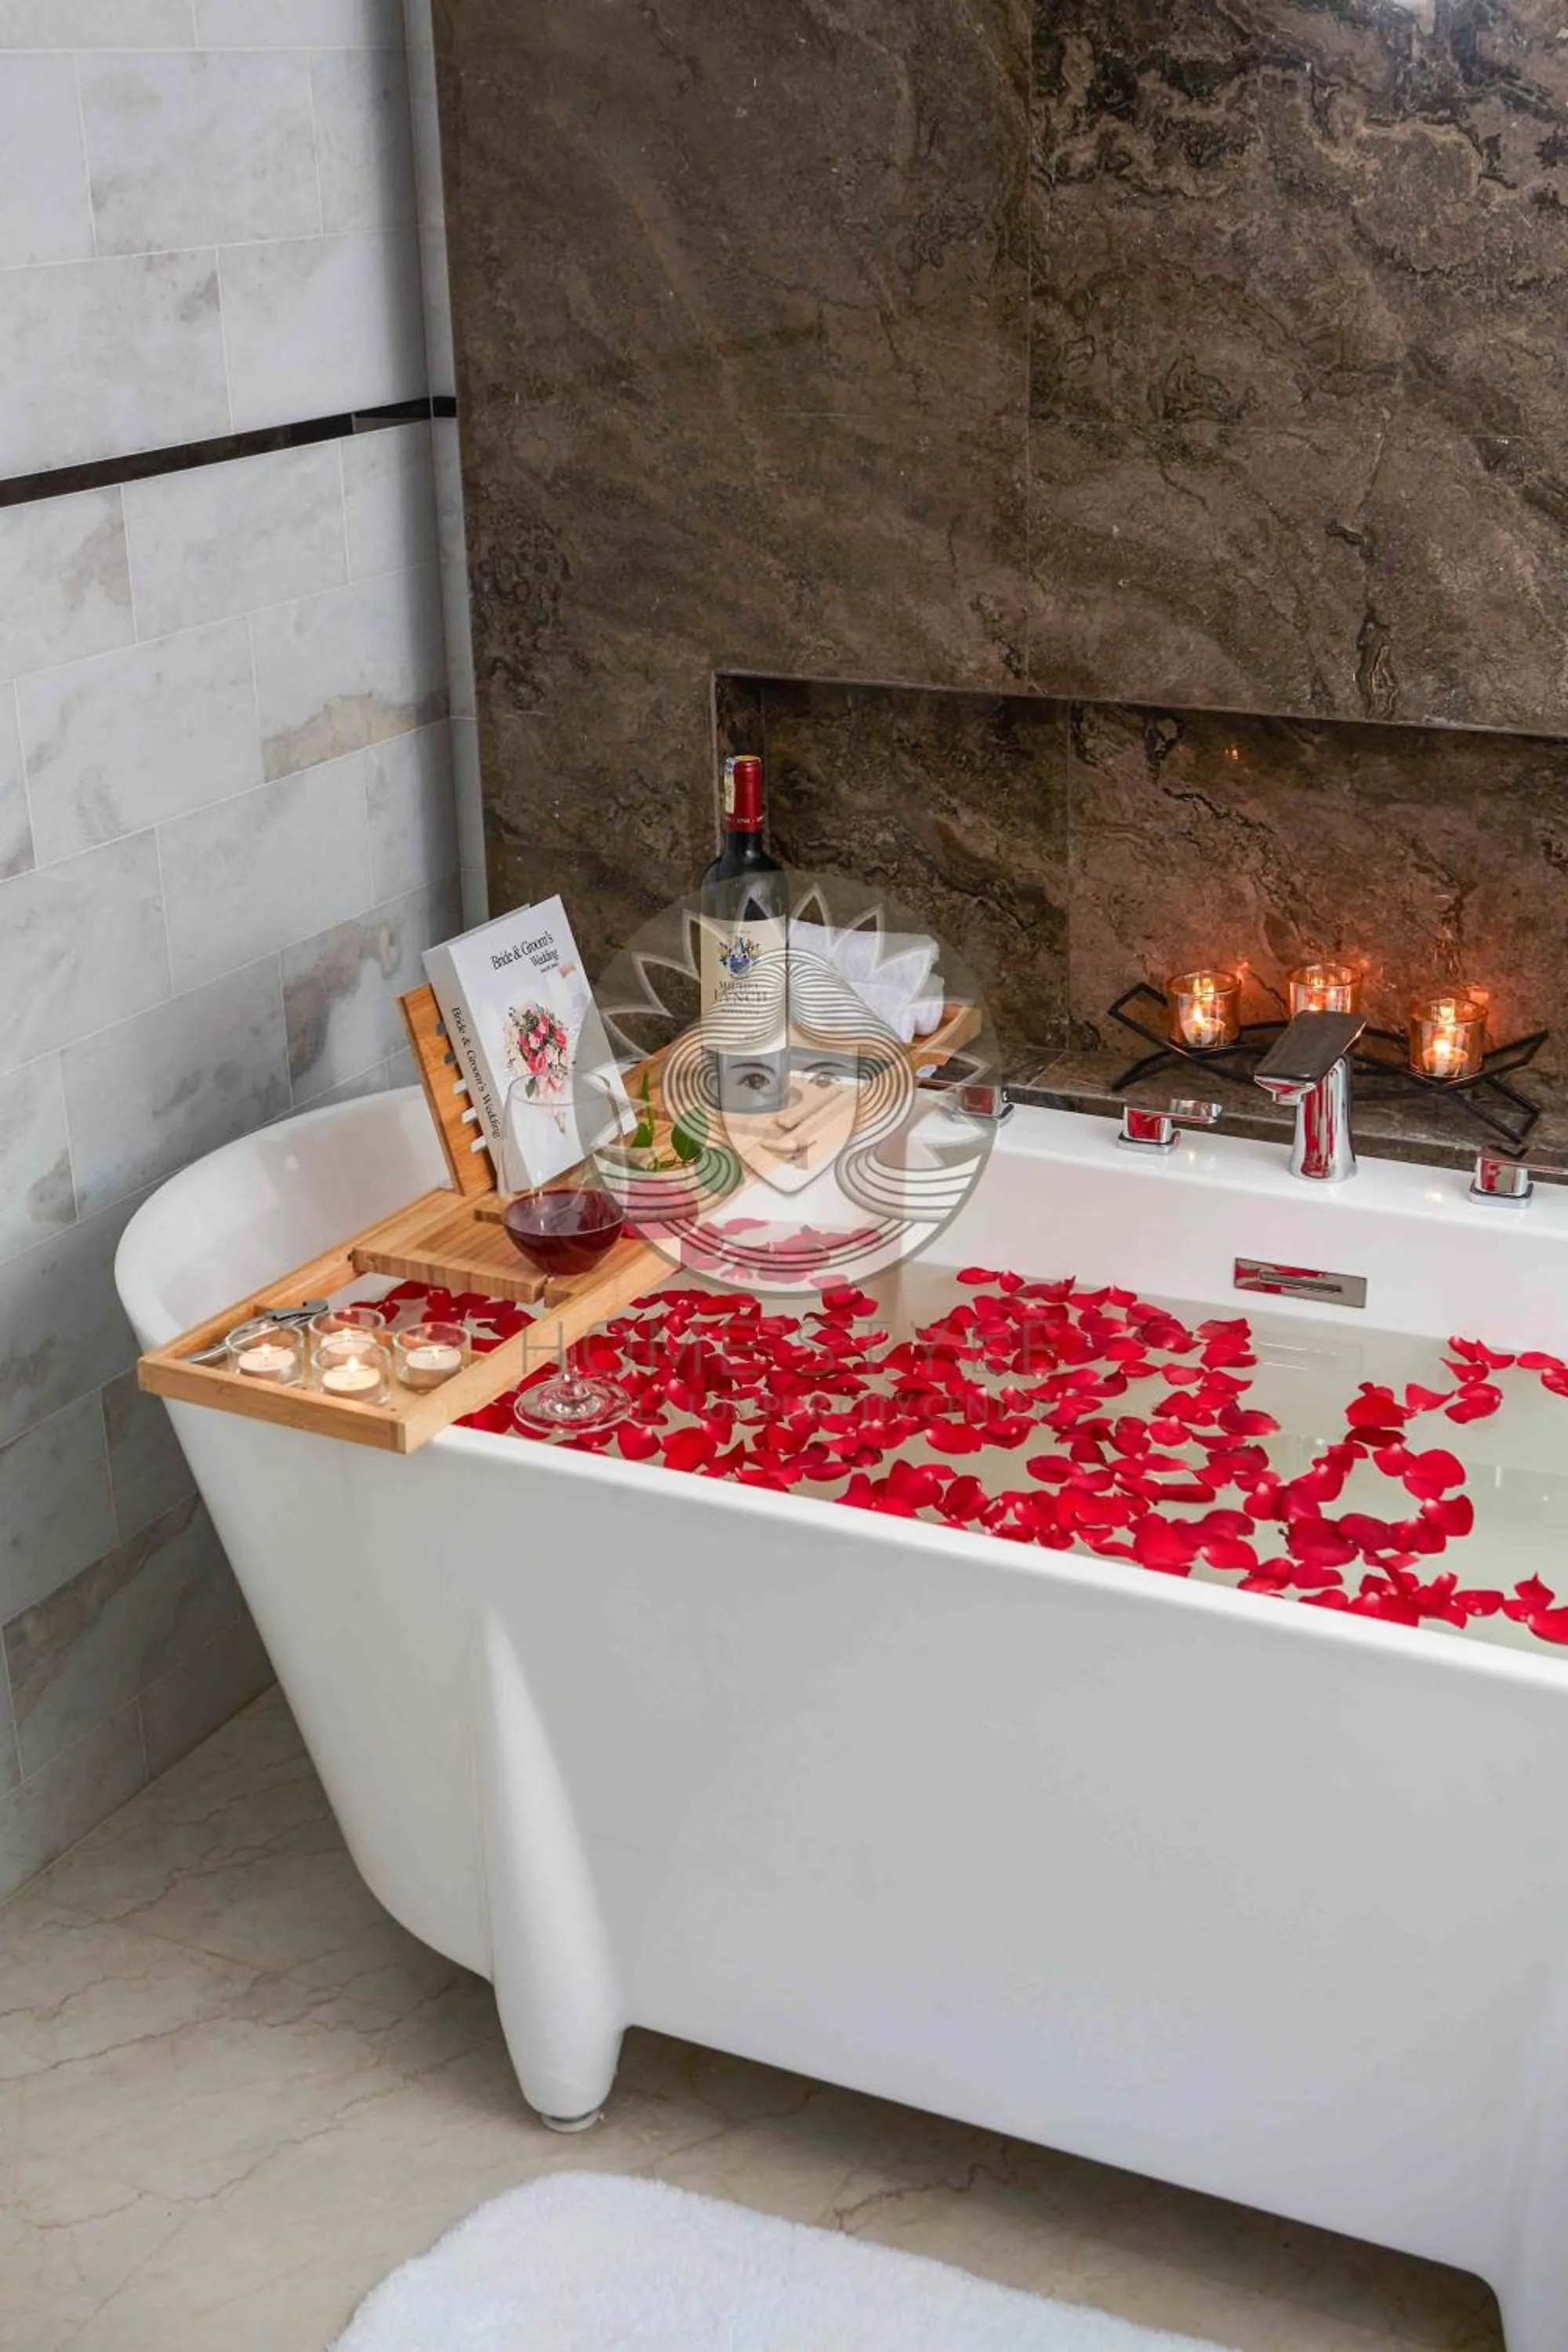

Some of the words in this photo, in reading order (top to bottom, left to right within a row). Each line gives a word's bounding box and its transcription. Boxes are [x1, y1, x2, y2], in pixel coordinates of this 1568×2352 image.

[491, 949, 514, 970] Bride
[514, 945, 523, 960] &
[452, 1006, 465, 1036] Bride
